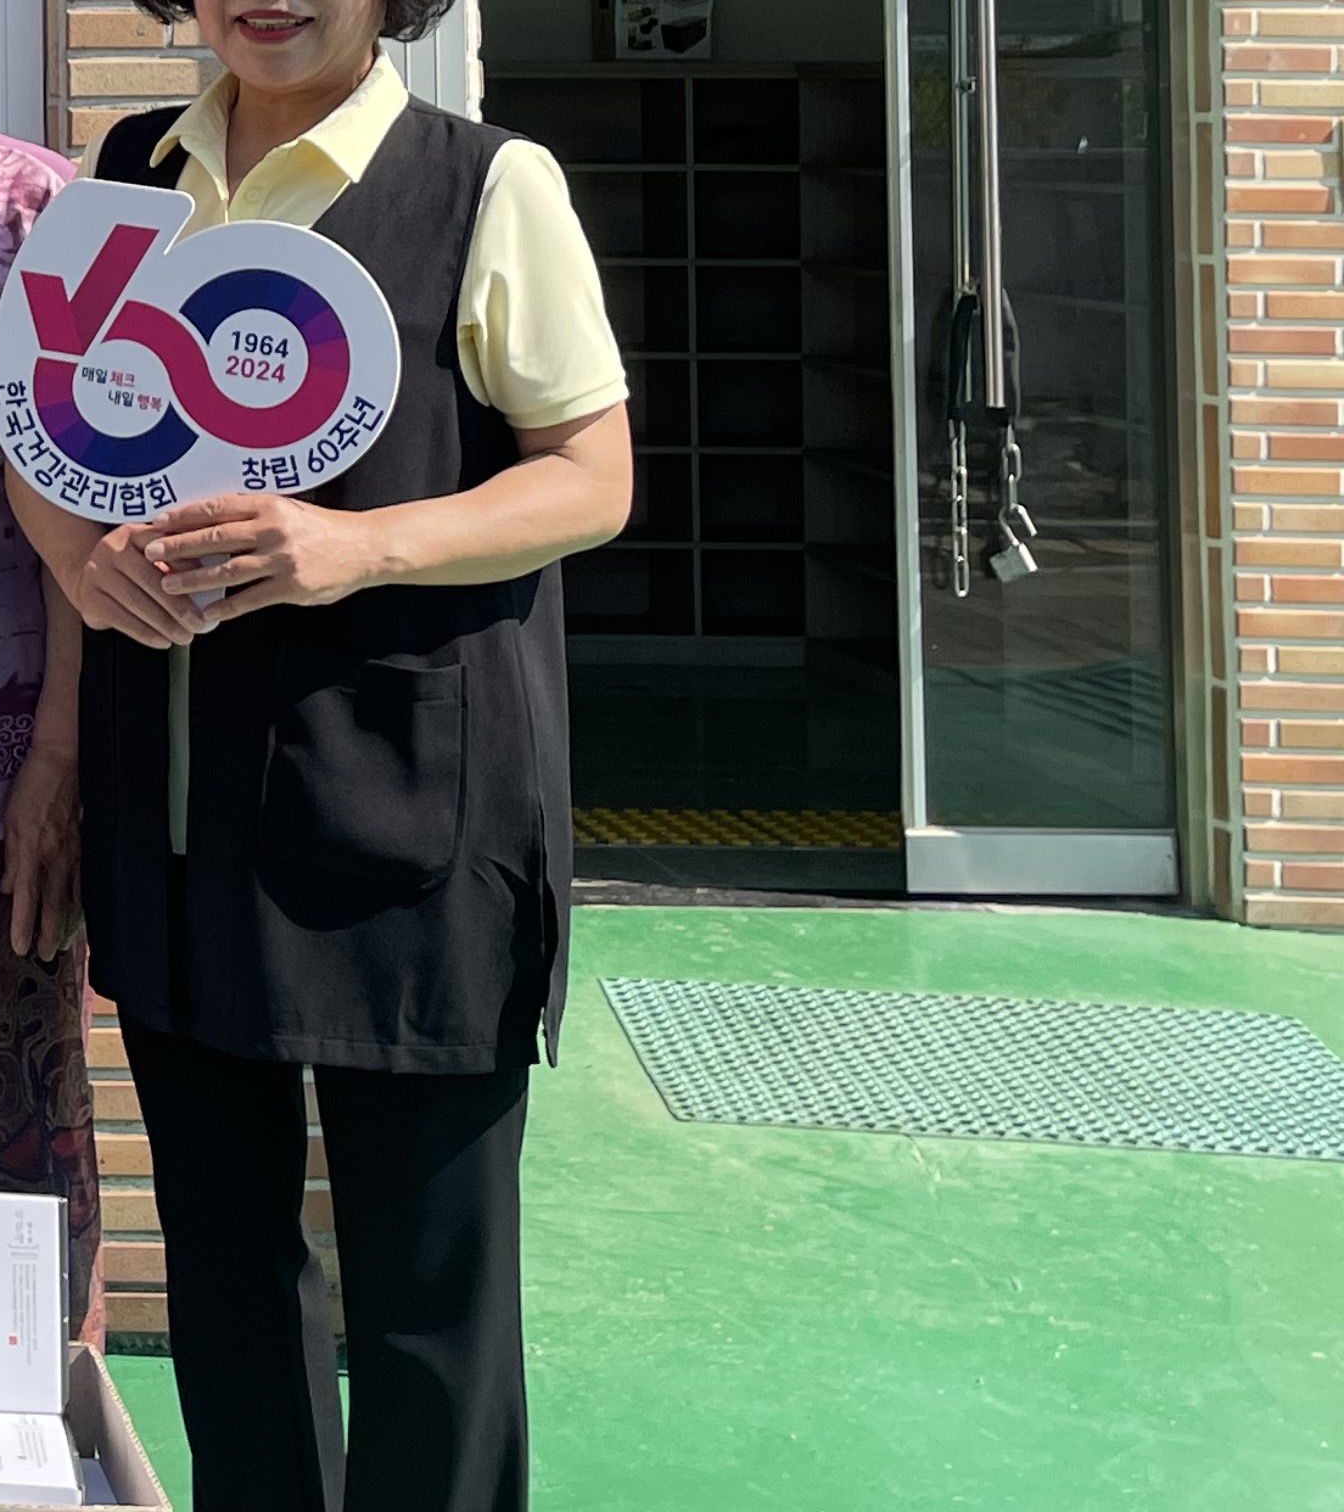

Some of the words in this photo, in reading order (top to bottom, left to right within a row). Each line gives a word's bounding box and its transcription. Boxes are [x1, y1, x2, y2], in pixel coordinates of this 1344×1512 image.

[231, 330, 289, 358] 1964
[82, 366, 108, 384] 매일
[225, 356, 286, 383] 2024
[108, 389, 134, 407] 내일
[241, 453, 301, 491] 창립
[305, 395, 385, 475] 60주년
